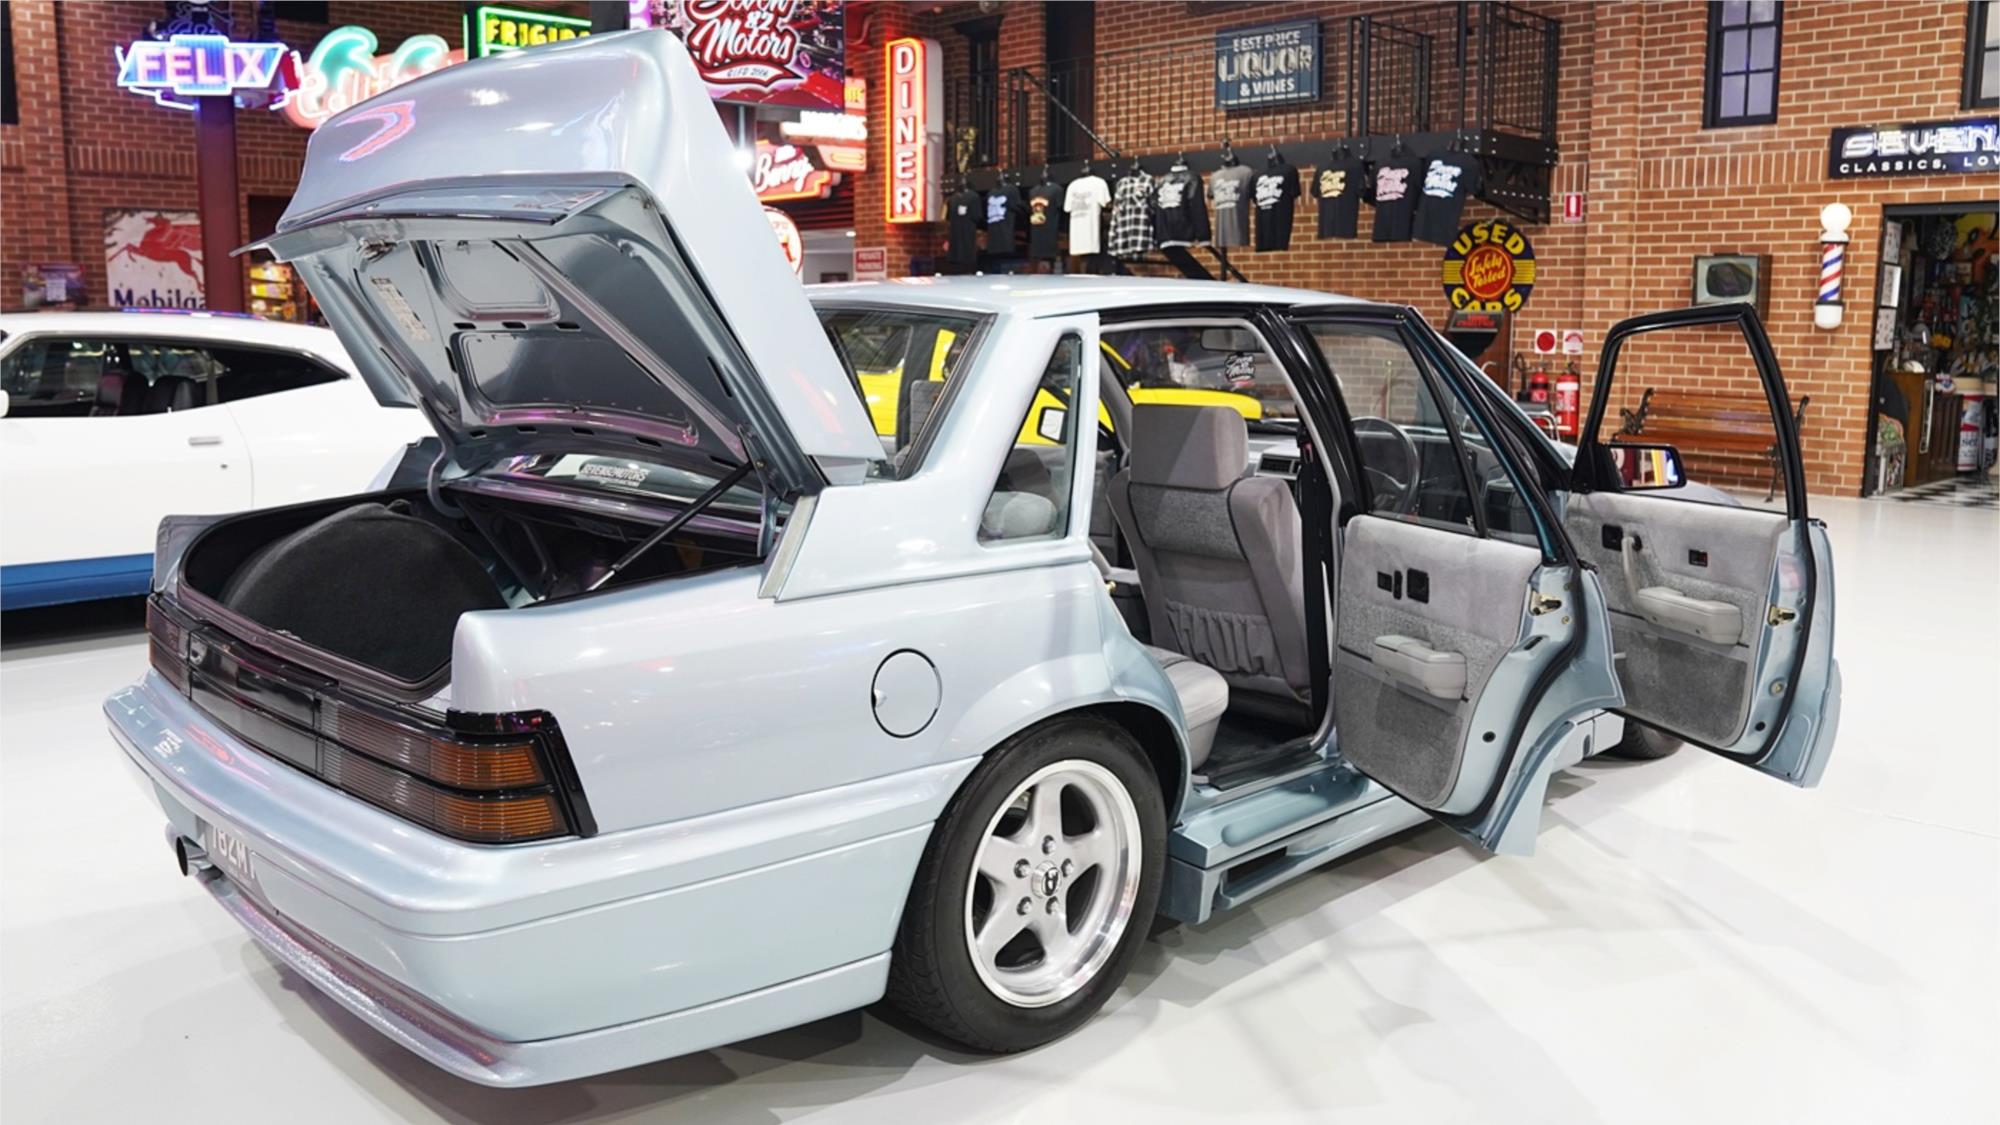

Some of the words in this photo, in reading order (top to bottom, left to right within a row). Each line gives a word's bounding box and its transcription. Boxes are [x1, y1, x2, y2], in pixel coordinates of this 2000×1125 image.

[486, 18, 591, 47] FRIGID
[745, 11, 774, 30] 82
[692, 18, 793, 63] Motors
[1264, 30, 1301, 48] PRICE
[136, 47, 267, 84] FELIX
[1218, 44, 1313, 82] LIQUOR
[1240, 83, 1251, 97] &
[1253, 78, 1295, 95] WINES
[895, 46, 916, 215] DINER
[1841, 124, 2000, 159] SEVEN
[1839, 159, 1947, 174] CLASSICS,
[1453, 222, 1525, 256] USED
[1469, 252, 1503, 276] Safety
[1472, 265, 1506, 289] Tested
